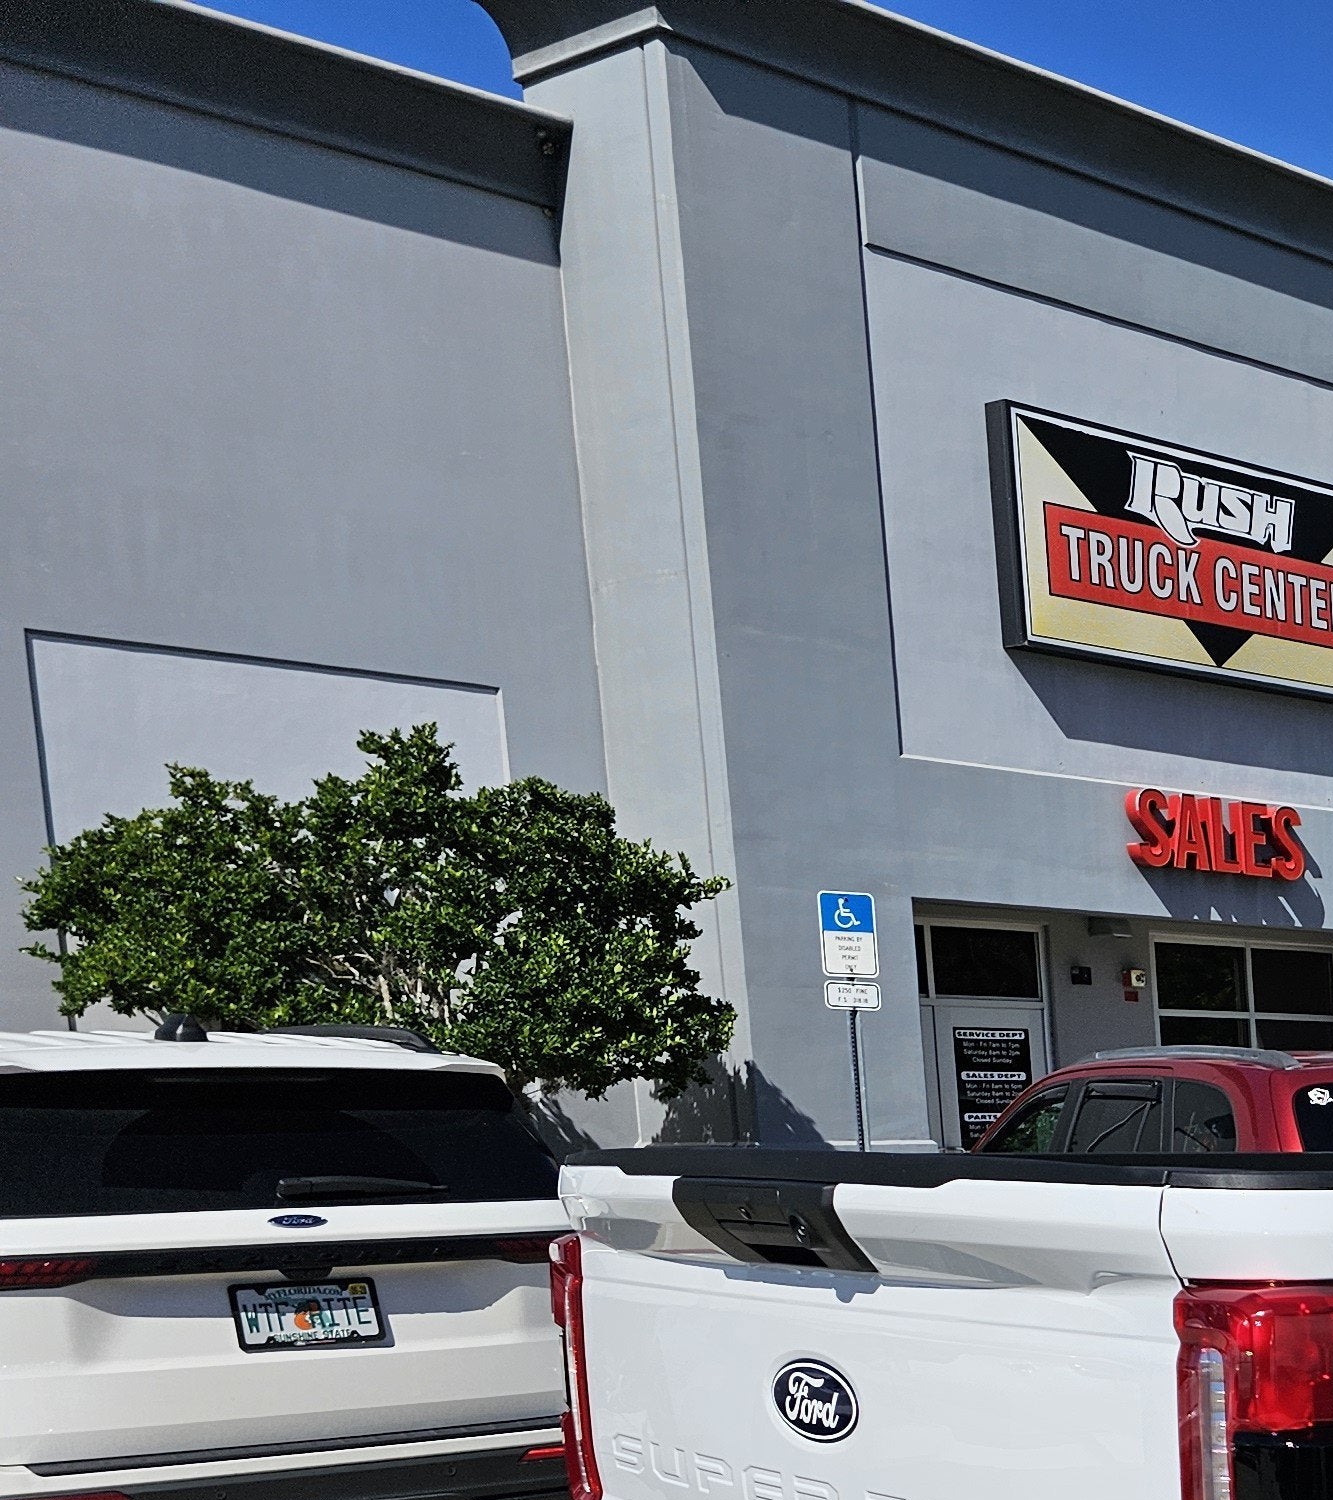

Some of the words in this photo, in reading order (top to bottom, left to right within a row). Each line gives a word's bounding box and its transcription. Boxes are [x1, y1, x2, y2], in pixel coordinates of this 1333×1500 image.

[1125, 451, 1295, 552] RUSH
[1061, 525, 1203, 605] TRUCK
[1126, 788, 1306, 880] SALES
[282, 1216, 314, 1225] Ford
[785, 1371, 840, 1430] Ford
